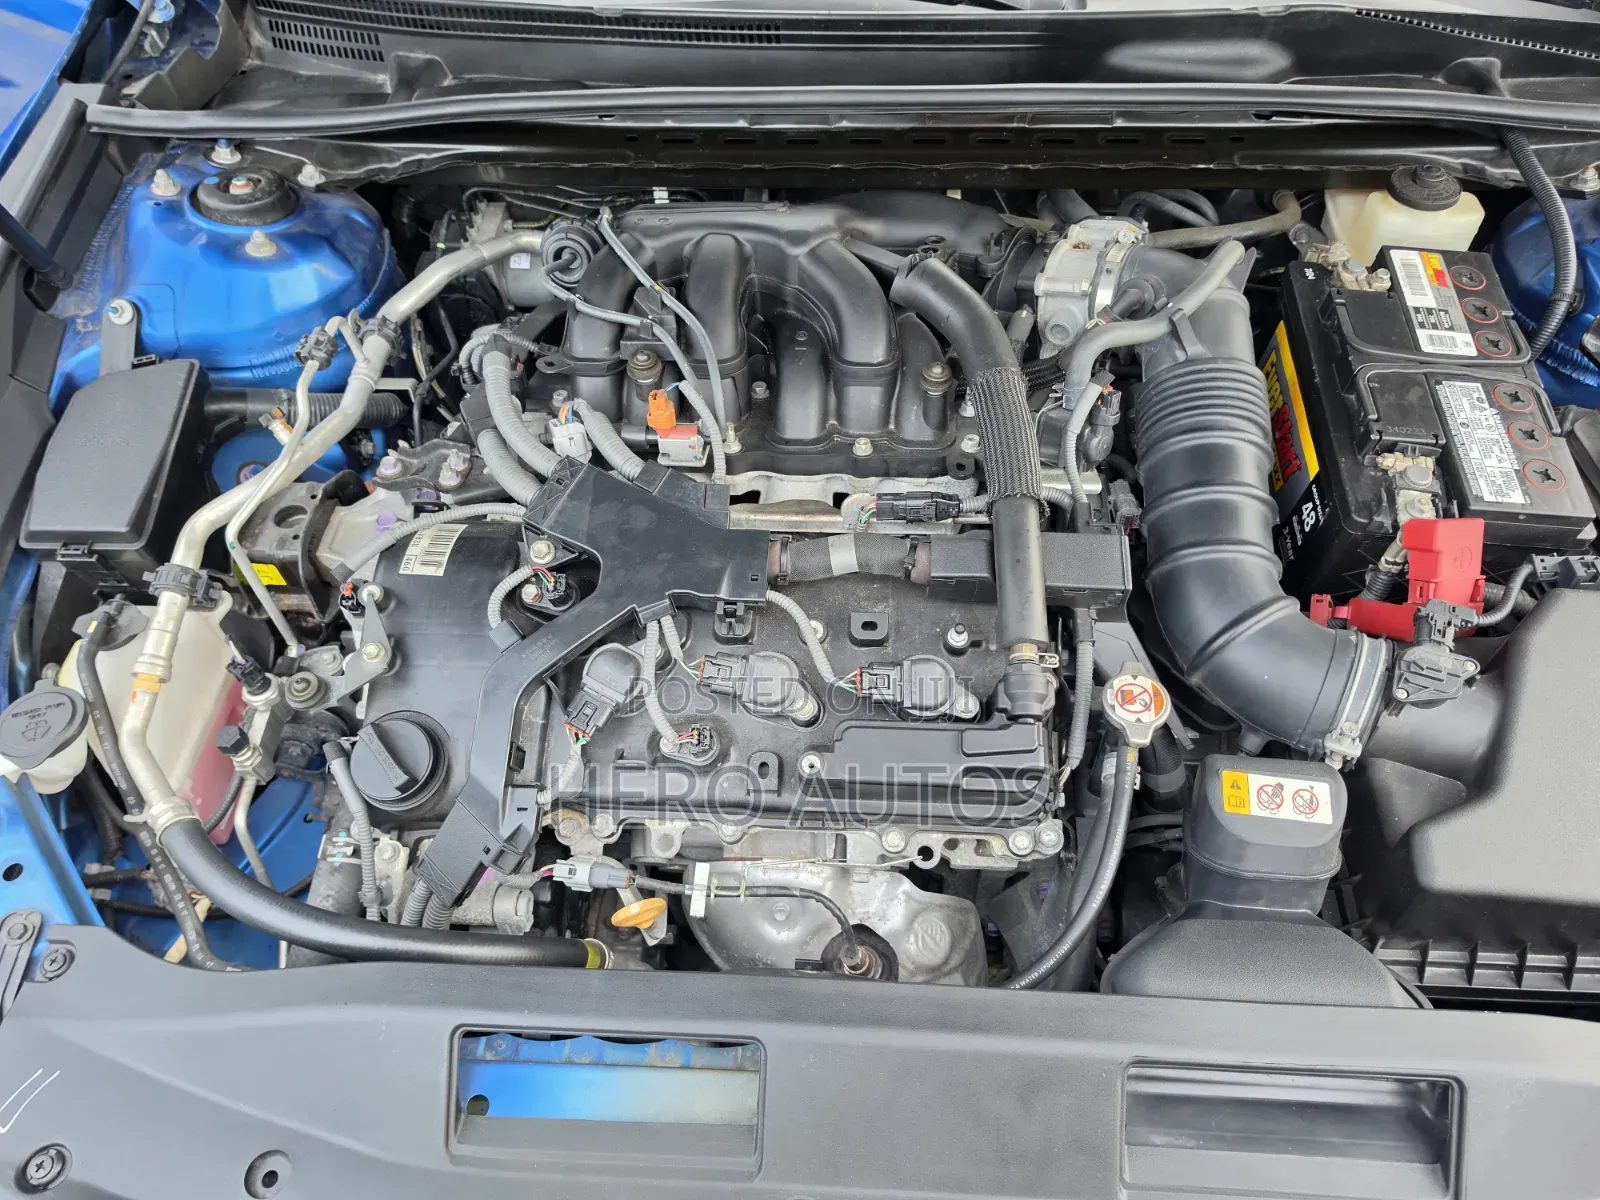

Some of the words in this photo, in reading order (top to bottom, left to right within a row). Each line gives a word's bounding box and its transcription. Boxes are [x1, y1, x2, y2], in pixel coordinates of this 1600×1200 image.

[1302, 501, 1316, 533] 48
[1282, 525, 1295, 561] 3-Year
[1020, 970, 1039, 987] WATER
